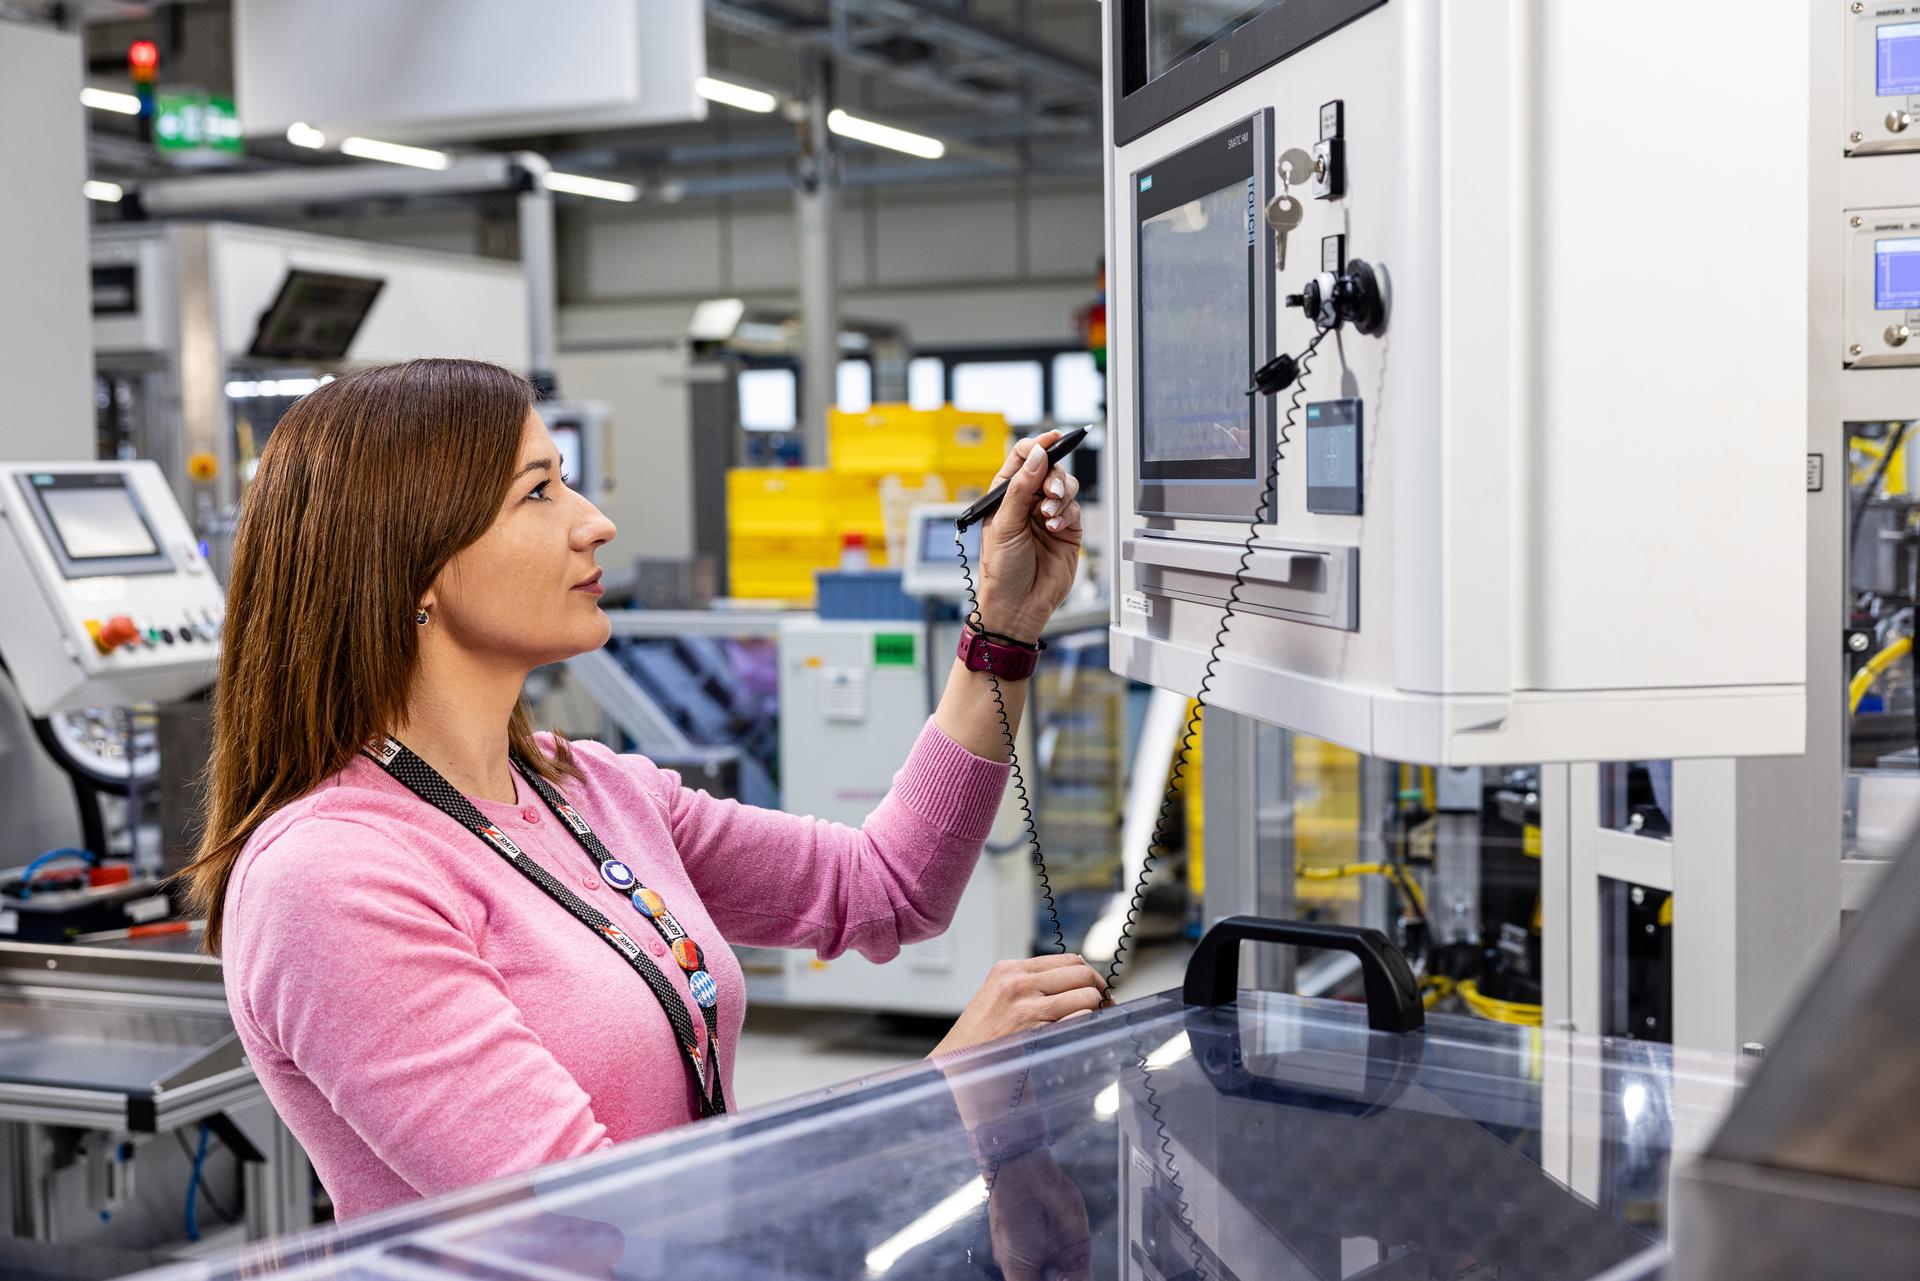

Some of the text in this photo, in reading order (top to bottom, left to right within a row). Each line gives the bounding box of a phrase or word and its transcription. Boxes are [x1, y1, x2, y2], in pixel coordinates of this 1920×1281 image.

[1247, 182, 1255, 244] TOUCH
[571, 813, 588, 831] GORE
[498, 836, 518, 854] GORE
[661, 914, 681, 936] GORE
[618, 935, 638, 954] GORE
